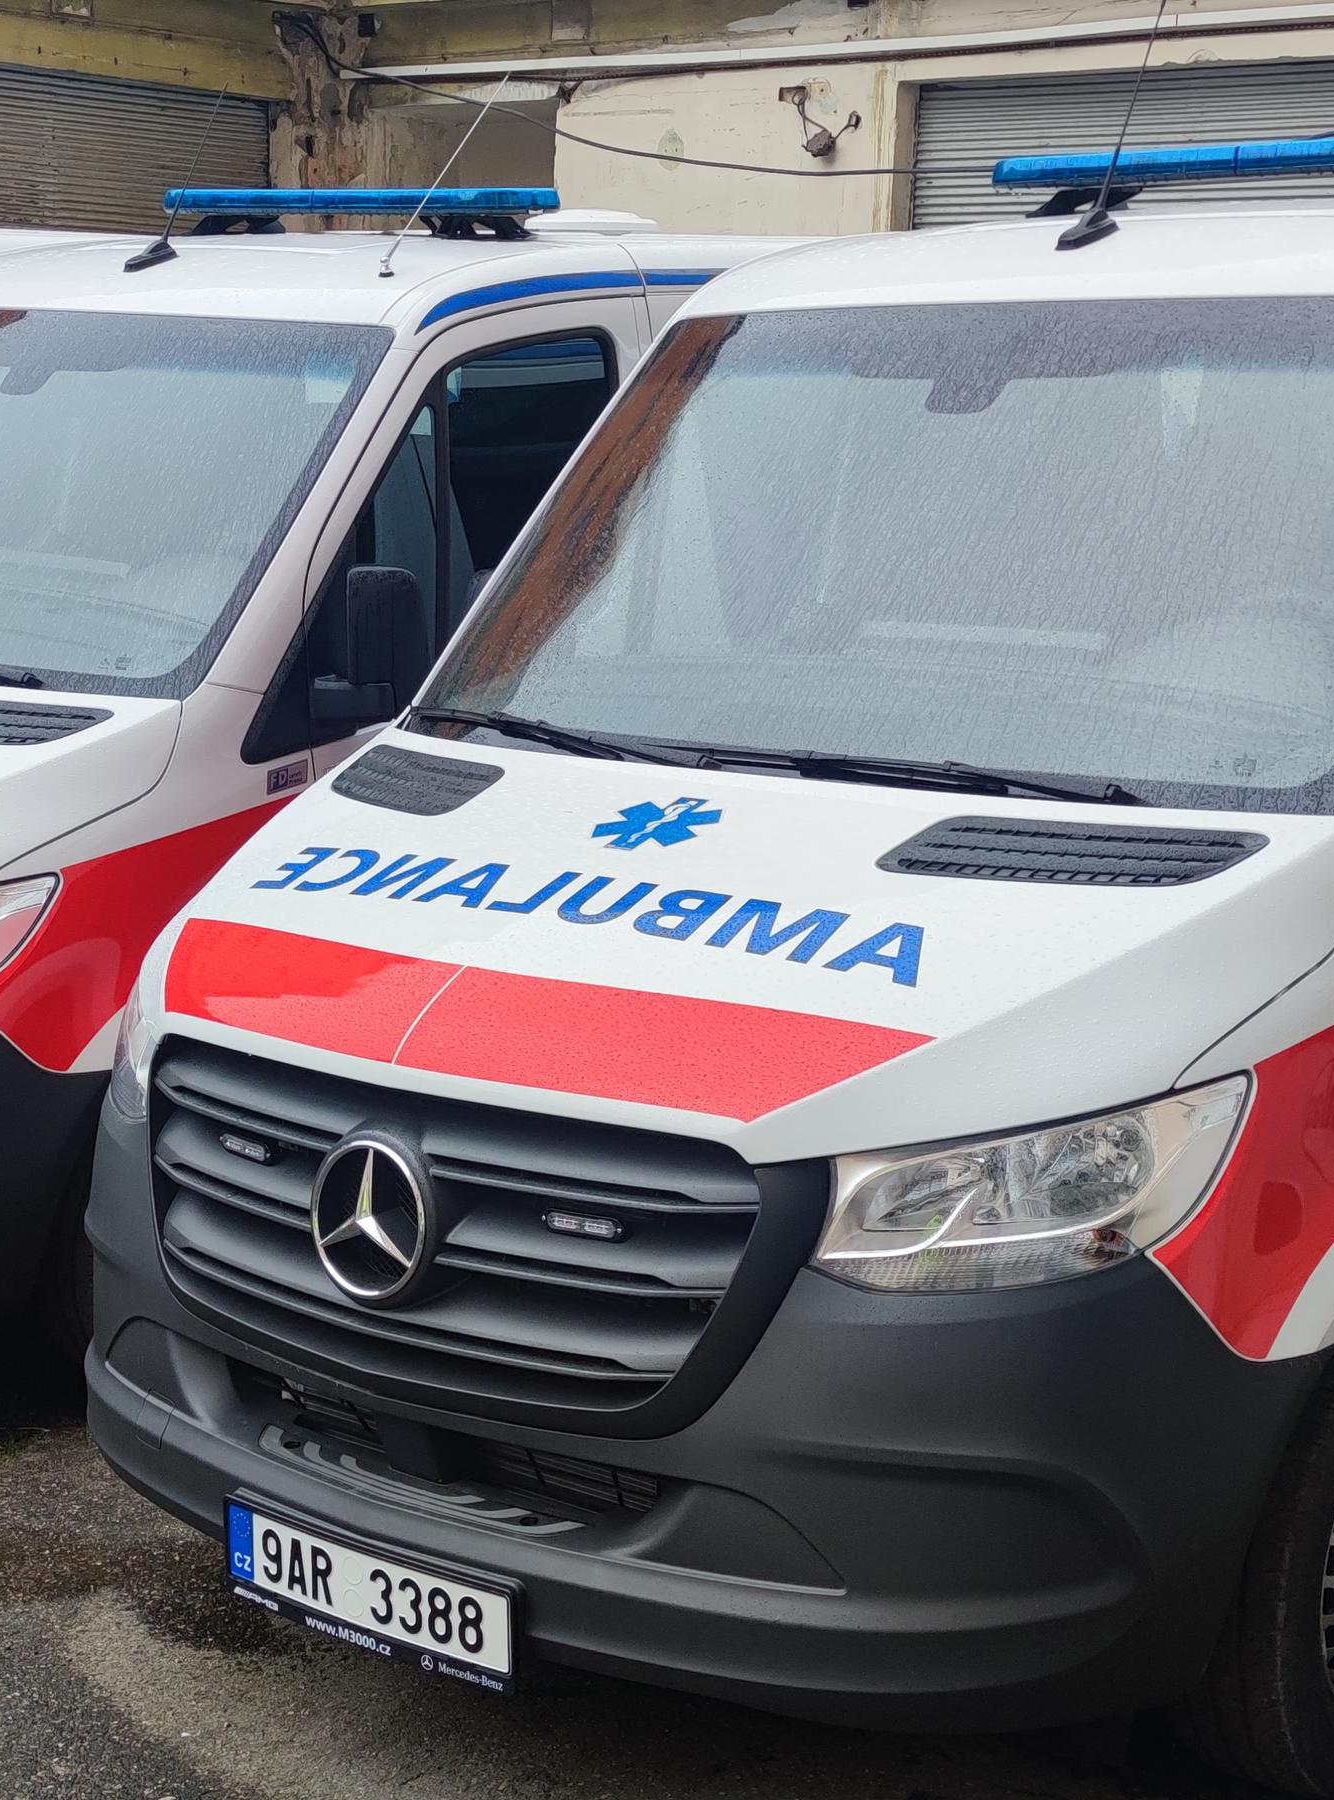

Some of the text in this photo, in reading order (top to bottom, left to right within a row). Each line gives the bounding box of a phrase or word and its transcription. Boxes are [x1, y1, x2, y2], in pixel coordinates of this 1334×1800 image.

[233, 1551, 252, 1573] CZ
[261, 1528, 485, 1654] 9AR 3388
[304, 1614, 392, 1657] www.M3000.cz
[437, 1660, 505, 1693] Mercedes-Benz
